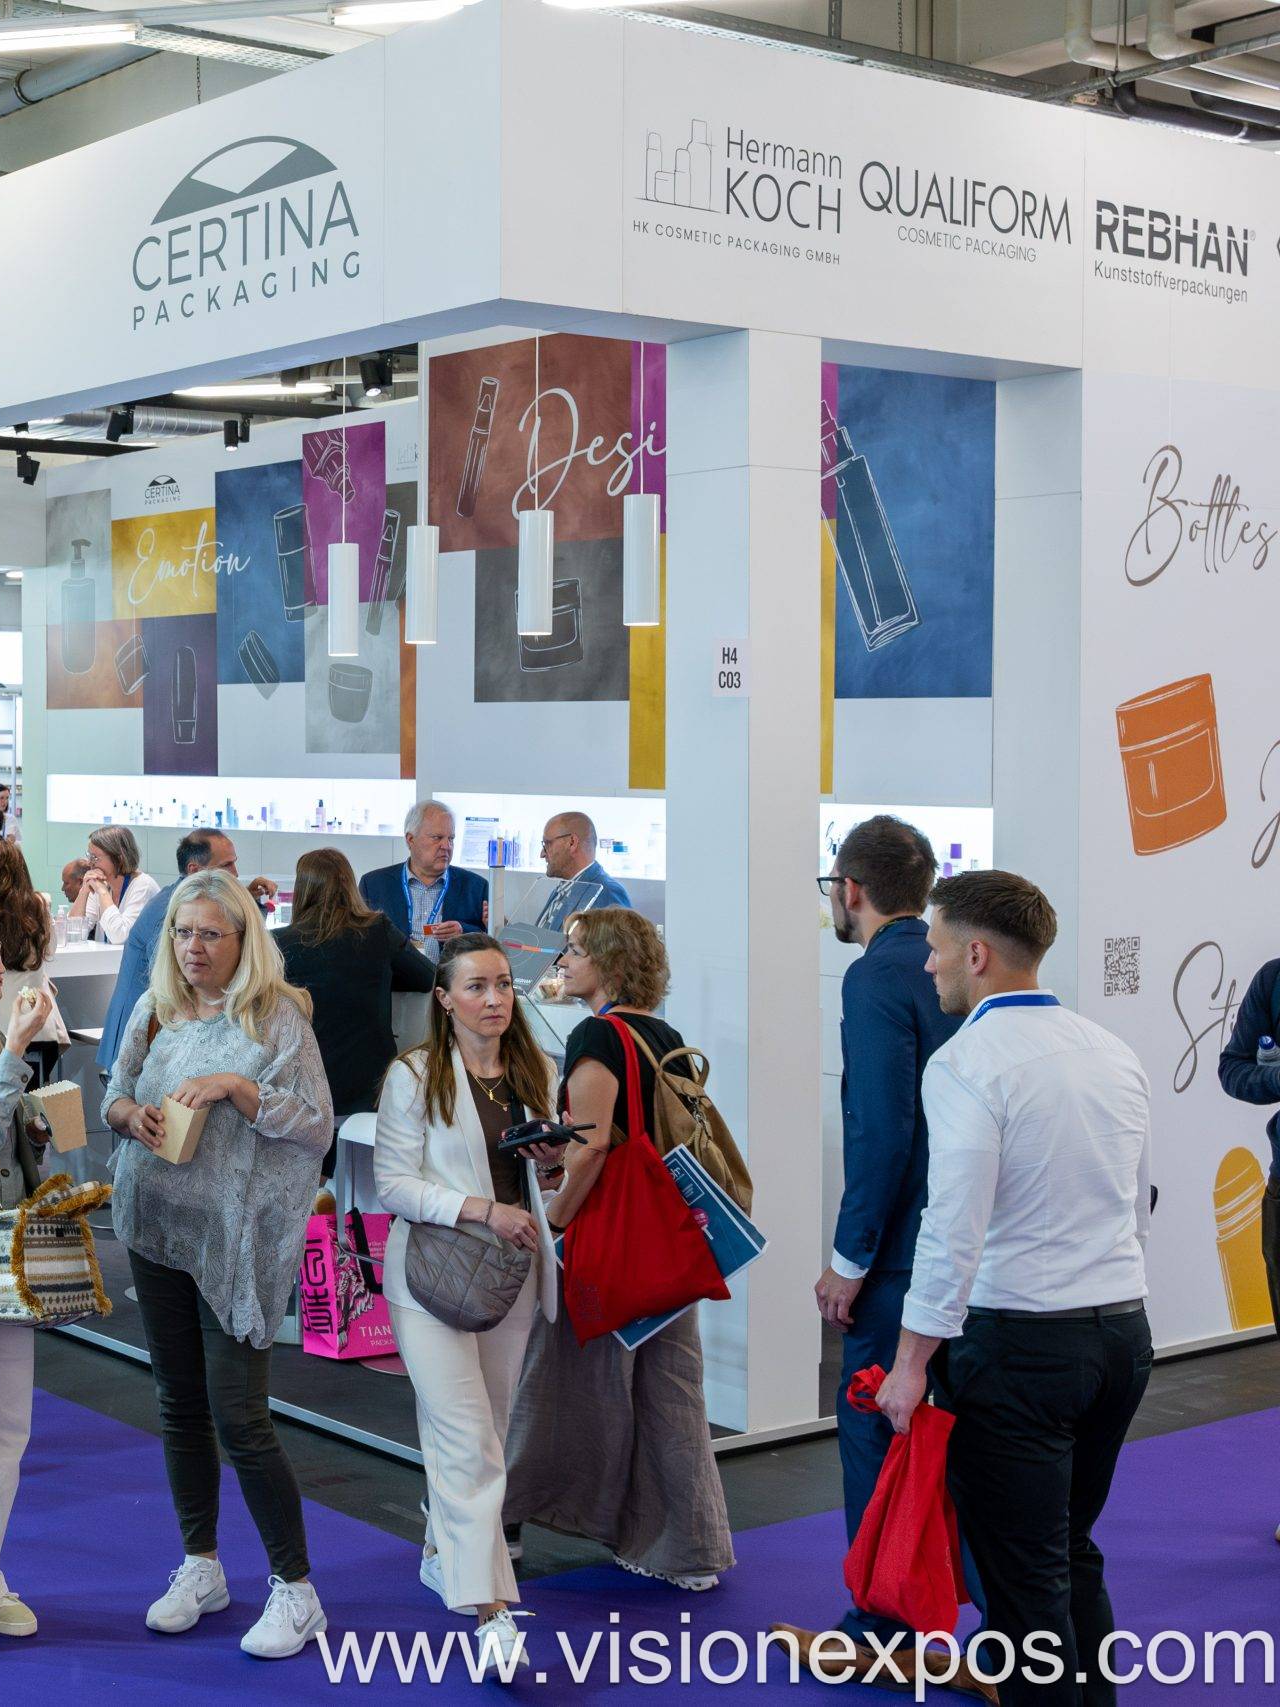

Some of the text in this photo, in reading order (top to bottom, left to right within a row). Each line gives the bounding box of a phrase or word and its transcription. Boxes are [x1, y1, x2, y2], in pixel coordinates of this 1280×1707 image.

[727, 127, 842, 179] Hermann
[726, 167, 841, 234] KOCH
[859, 161, 1072, 244] QUALIFORM
[132, 180, 360, 291] CERTINA
[633, 220, 841, 265] HK COSMETIC PACKAGING GMBH
[897, 225, 1037, 263] COSMETIC PACKAGING
[133, 251, 360, 330] PACKAGING
[1094, 260, 1248, 304] Kunststoffverpackungen
[145, 485, 180, 498] CERTINA
[1124, 444, 1278, 587] Bottles
[127, 520, 251, 605] Emotion
[718, 671, 741, 690] C03
[721, 647, 738, 665] H4
